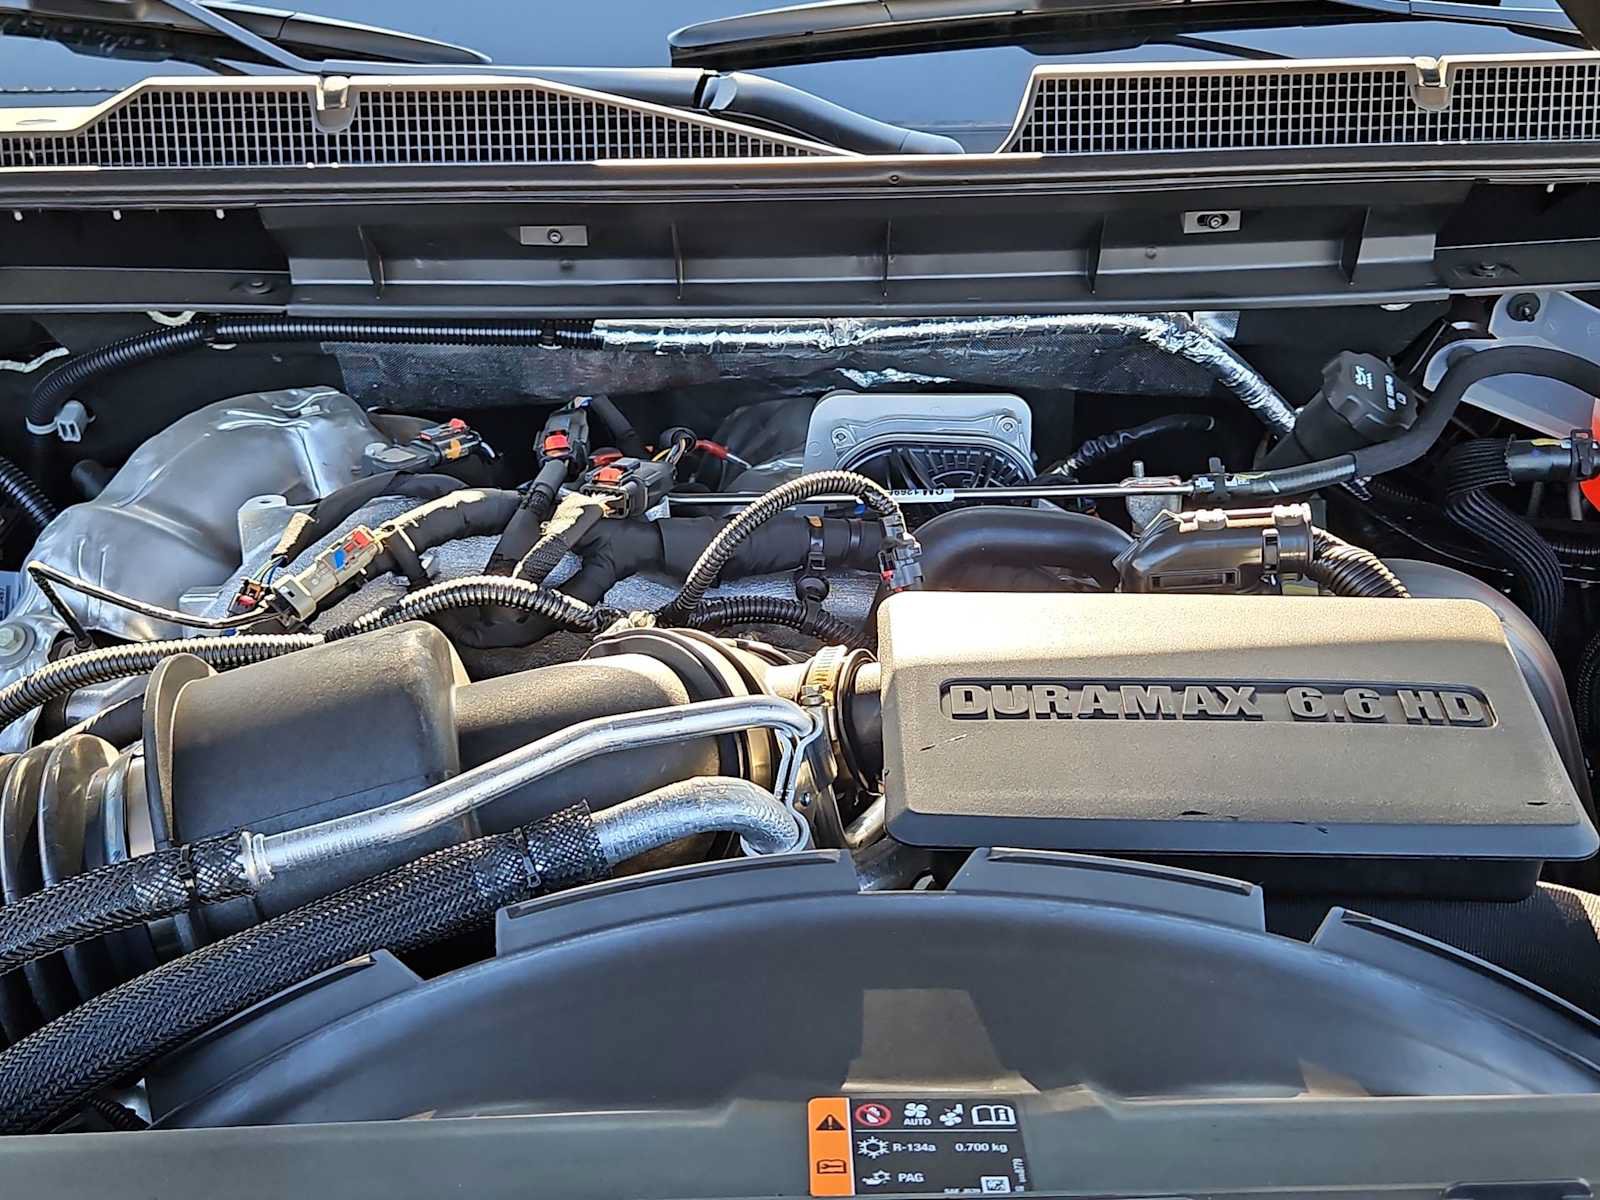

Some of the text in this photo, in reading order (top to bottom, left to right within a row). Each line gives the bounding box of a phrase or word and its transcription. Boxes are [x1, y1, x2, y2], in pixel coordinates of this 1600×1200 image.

[949, 684, 1488, 727] DURAMAX 6.6 HD
[903, 1117, 932, 1126] AUTO
[892, 1142, 1008, 1153] R-134a 0.700 kg
[898, 1172, 925, 1182] PAG
